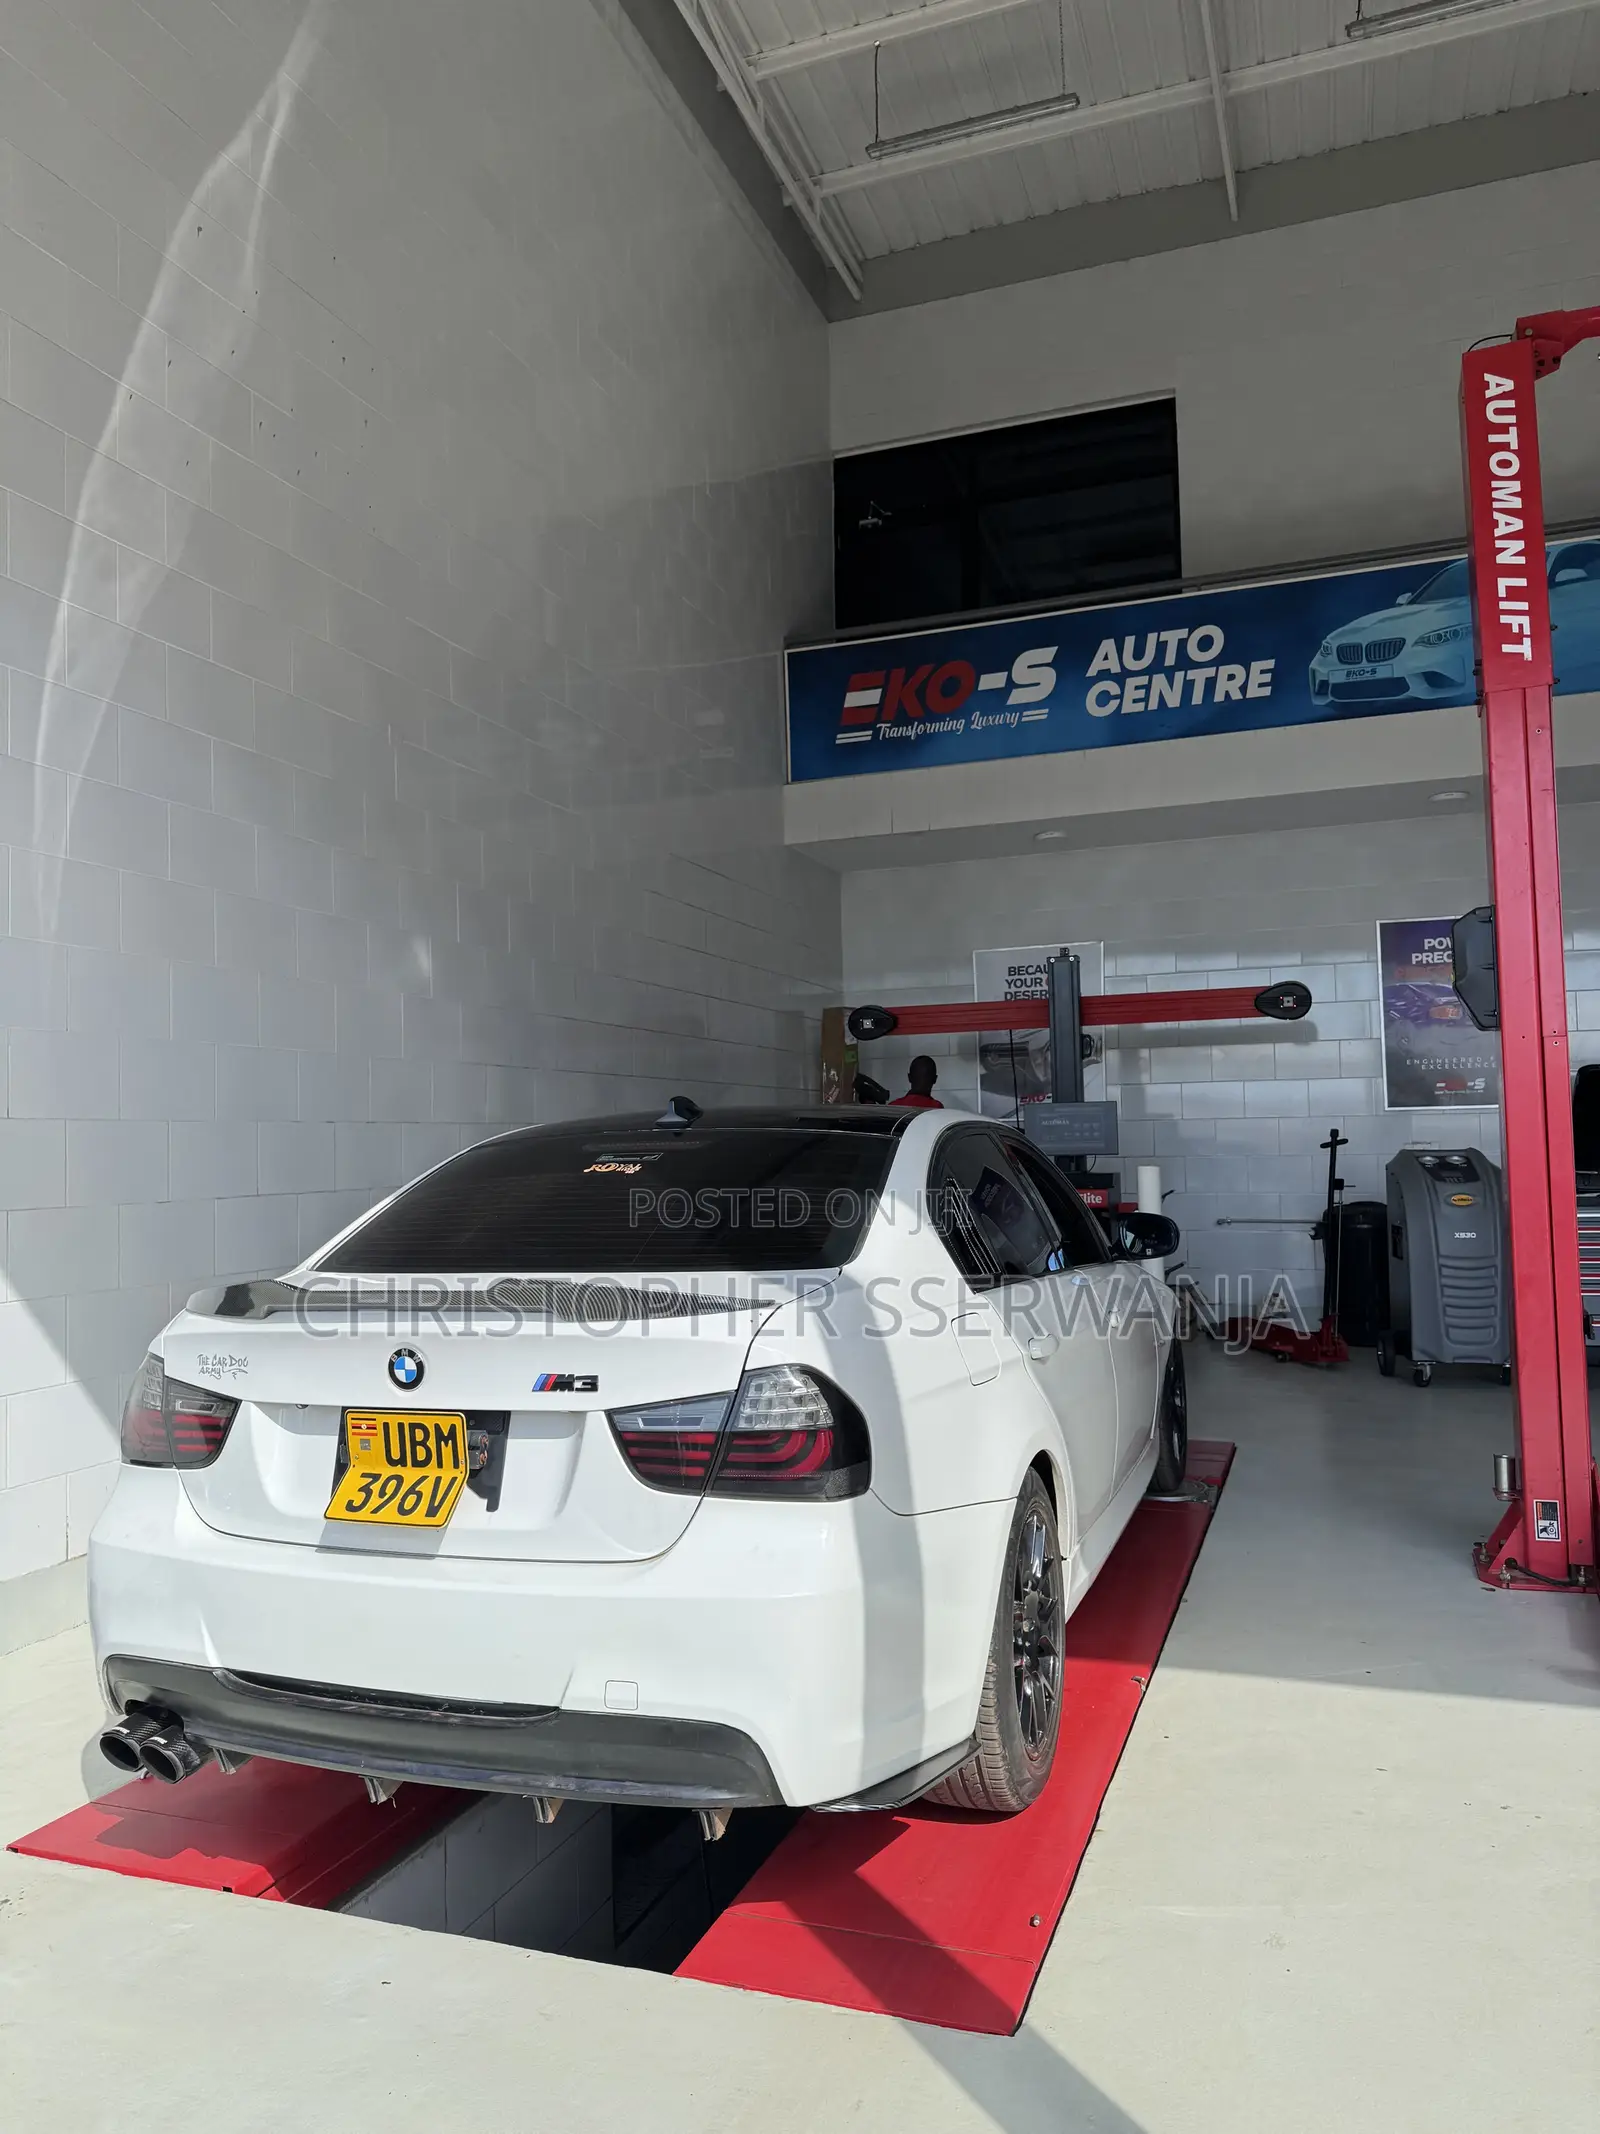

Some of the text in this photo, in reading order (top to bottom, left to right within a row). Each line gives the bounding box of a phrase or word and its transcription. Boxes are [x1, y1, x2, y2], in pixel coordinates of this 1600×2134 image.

[1483, 372, 1533, 661] AUTOMAN LIFT
[1085, 624, 1225, 677] AUTO
[840, 646, 1059, 726] EKO-S
[1085, 659, 1276, 718] CENTRE
[876, 710, 1020, 740] Transforming Luxury
[1005, 977, 1043, 989] YOUR
[390, 1348, 422, 1363] BMW
[548, 1373, 599, 1392] M3
[382, 1422, 460, 1469] UBM
[345, 1472, 459, 1518] 396V
